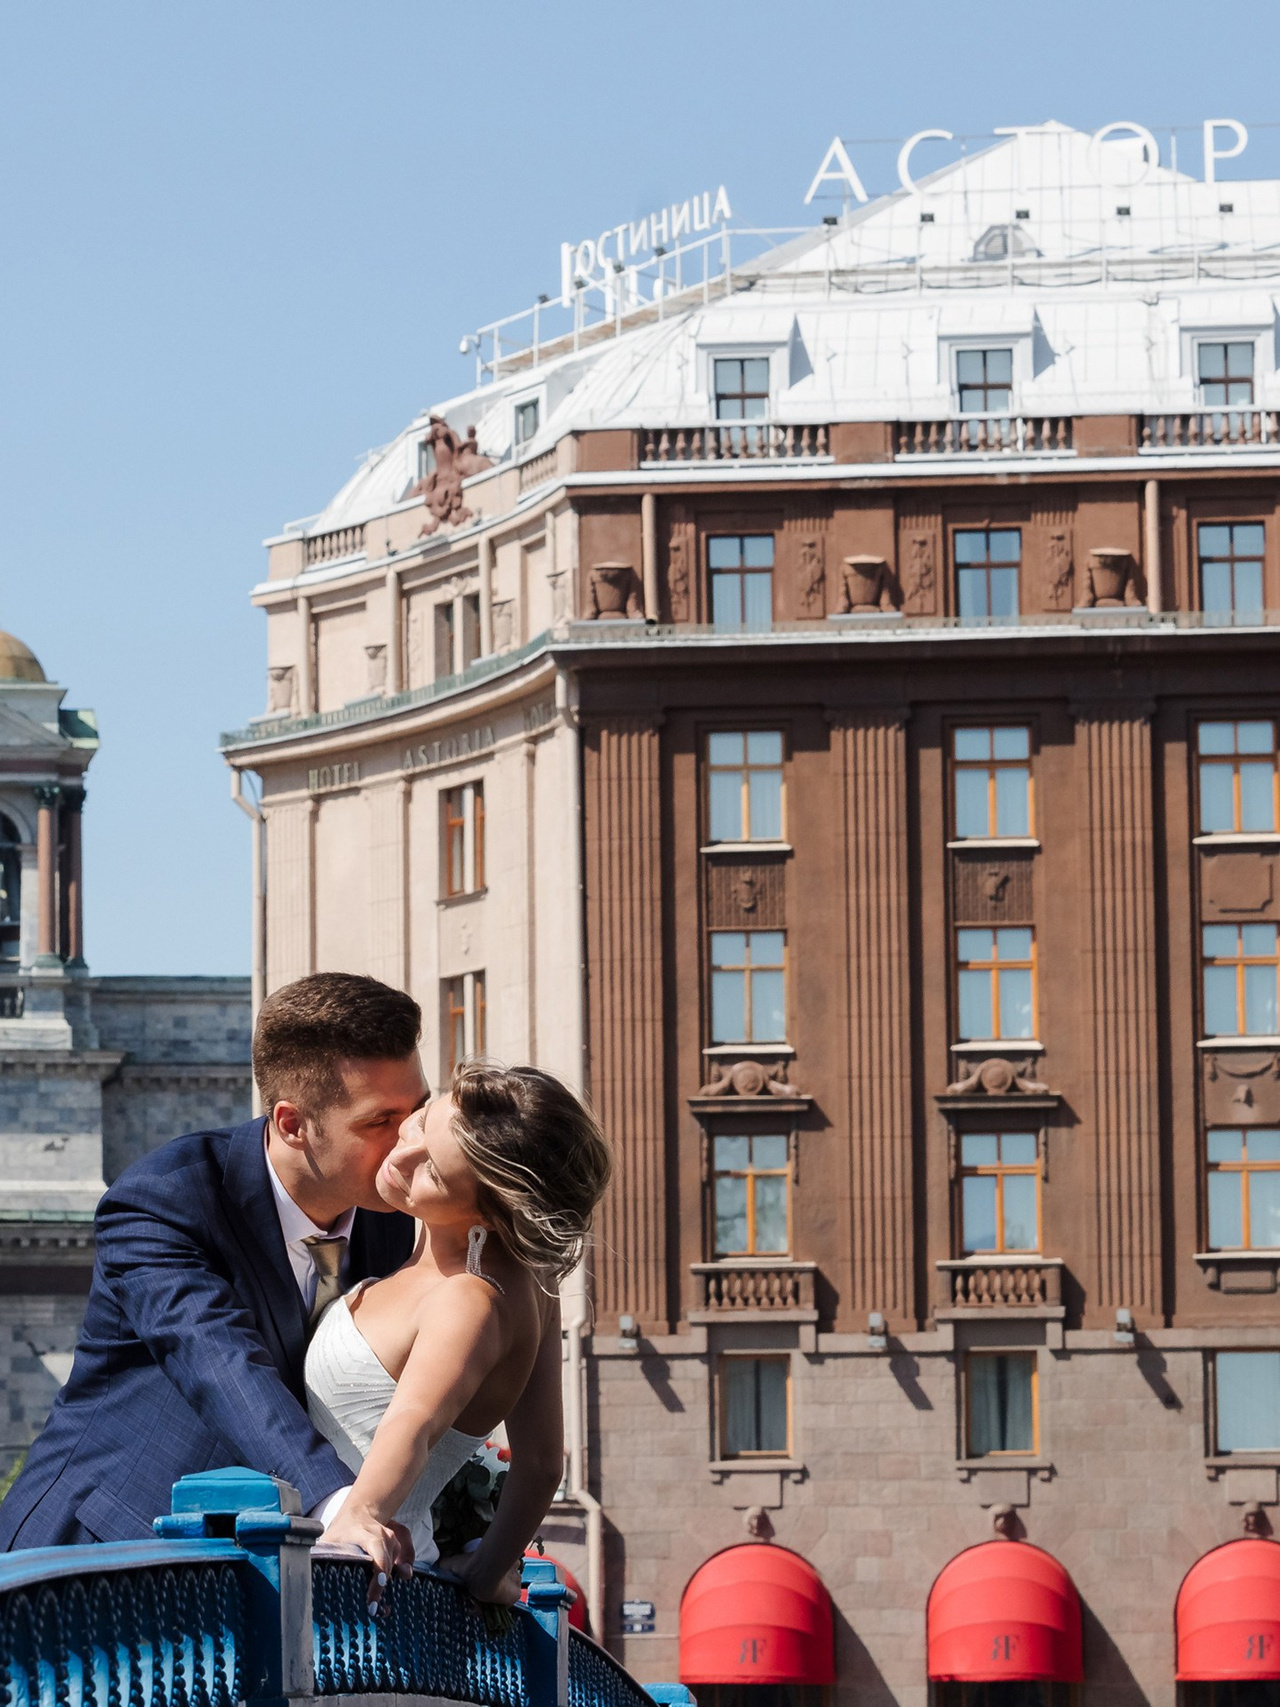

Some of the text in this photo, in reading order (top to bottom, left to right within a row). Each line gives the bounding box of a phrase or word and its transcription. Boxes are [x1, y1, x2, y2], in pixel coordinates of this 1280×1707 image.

[561, 184, 732, 292] ГОСТИНИЦА
[308, 726, 496, 792] HOTEL ASTORIA
